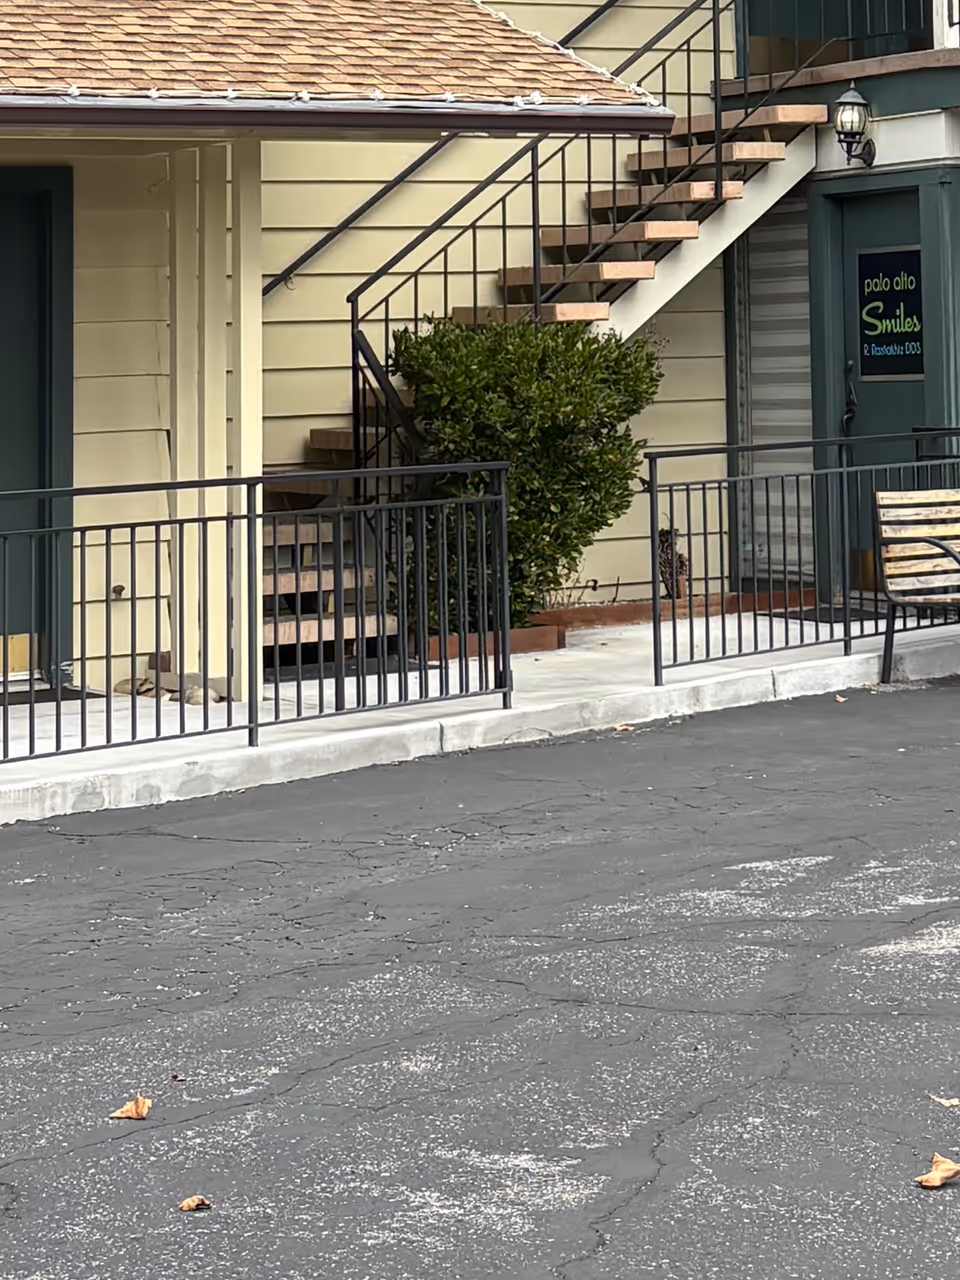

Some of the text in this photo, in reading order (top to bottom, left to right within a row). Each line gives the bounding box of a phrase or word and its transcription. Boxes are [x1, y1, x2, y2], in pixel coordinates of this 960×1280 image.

[864, 271, 916, 296] palo alto
[862, 301, 921, 336] Smiles
